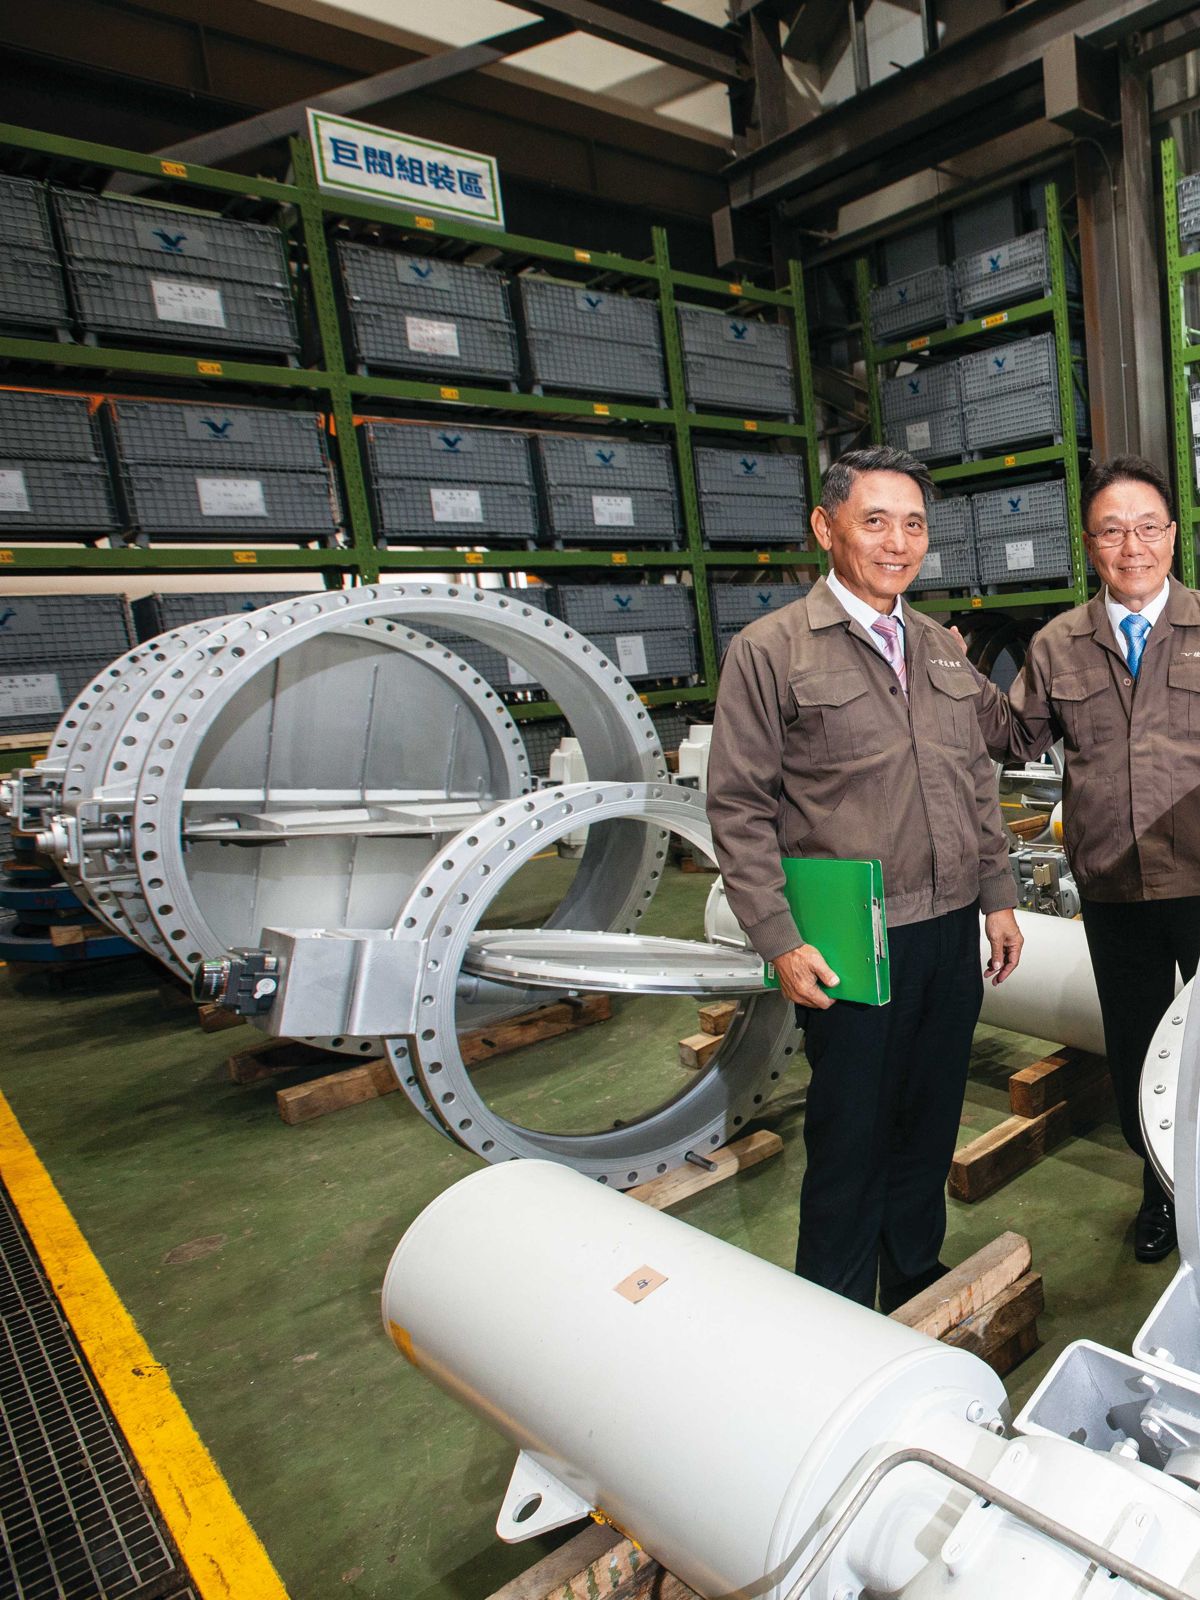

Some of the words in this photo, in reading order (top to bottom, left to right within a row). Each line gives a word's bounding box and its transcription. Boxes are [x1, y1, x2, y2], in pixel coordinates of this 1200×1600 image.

[329, 137, 486, 199] 巨閥組裝區
